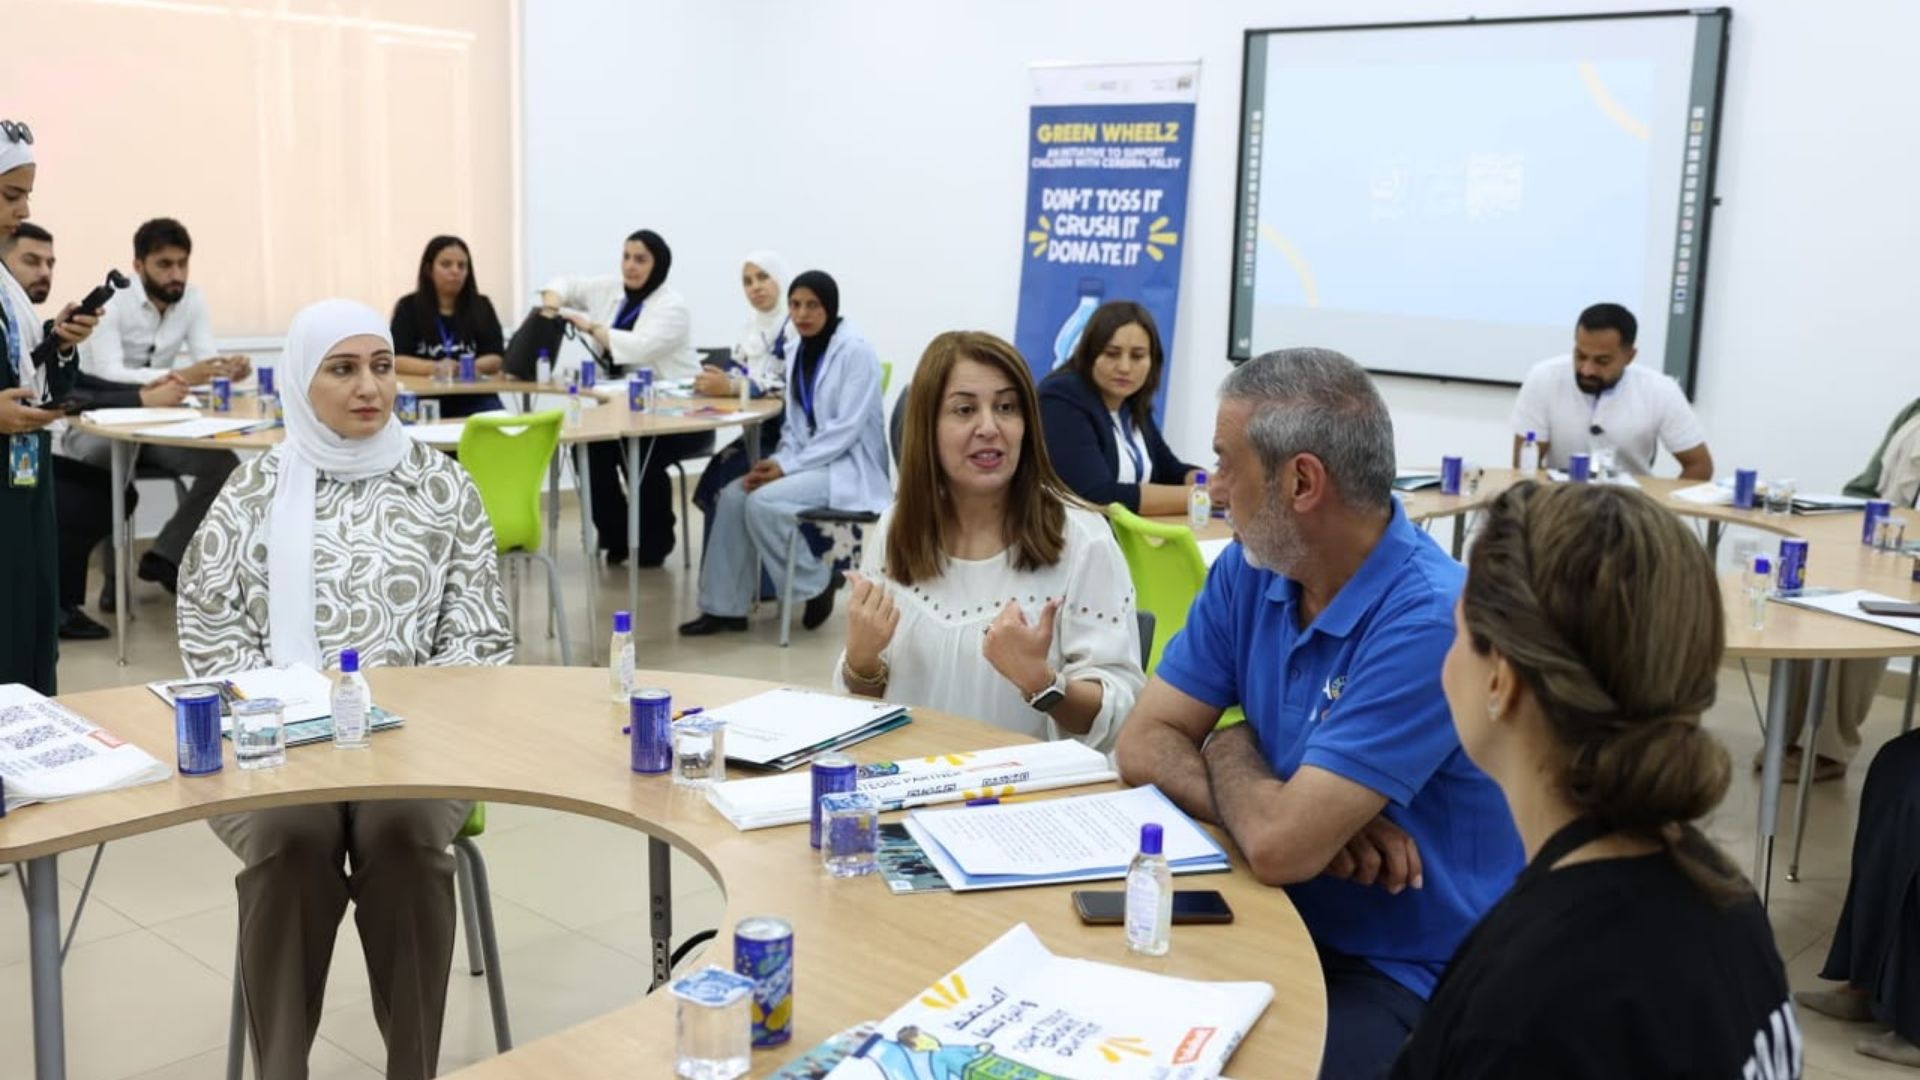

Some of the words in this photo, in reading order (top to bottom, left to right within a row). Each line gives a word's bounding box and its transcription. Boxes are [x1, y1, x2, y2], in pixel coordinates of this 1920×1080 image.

[1037, 123, 1097, 143] GREEN
[1102, 122, 1179, 143] WHEELZ
[1075, 158, 1100, 169] WITH
[1149, 158, 1181, 169] PALSY
[1042, 188, 1093, 210] DON'T
[1096, 189, 1141, 212] TOSS
[1143, 189, 1163, 212] IT
[1055, 213, 1120, 238] CRUSH
[1122, 216, 1140, 239] IT
[1047, 240, 1123, 265] DONATE
[1124, 243, 1141, 265] IT
